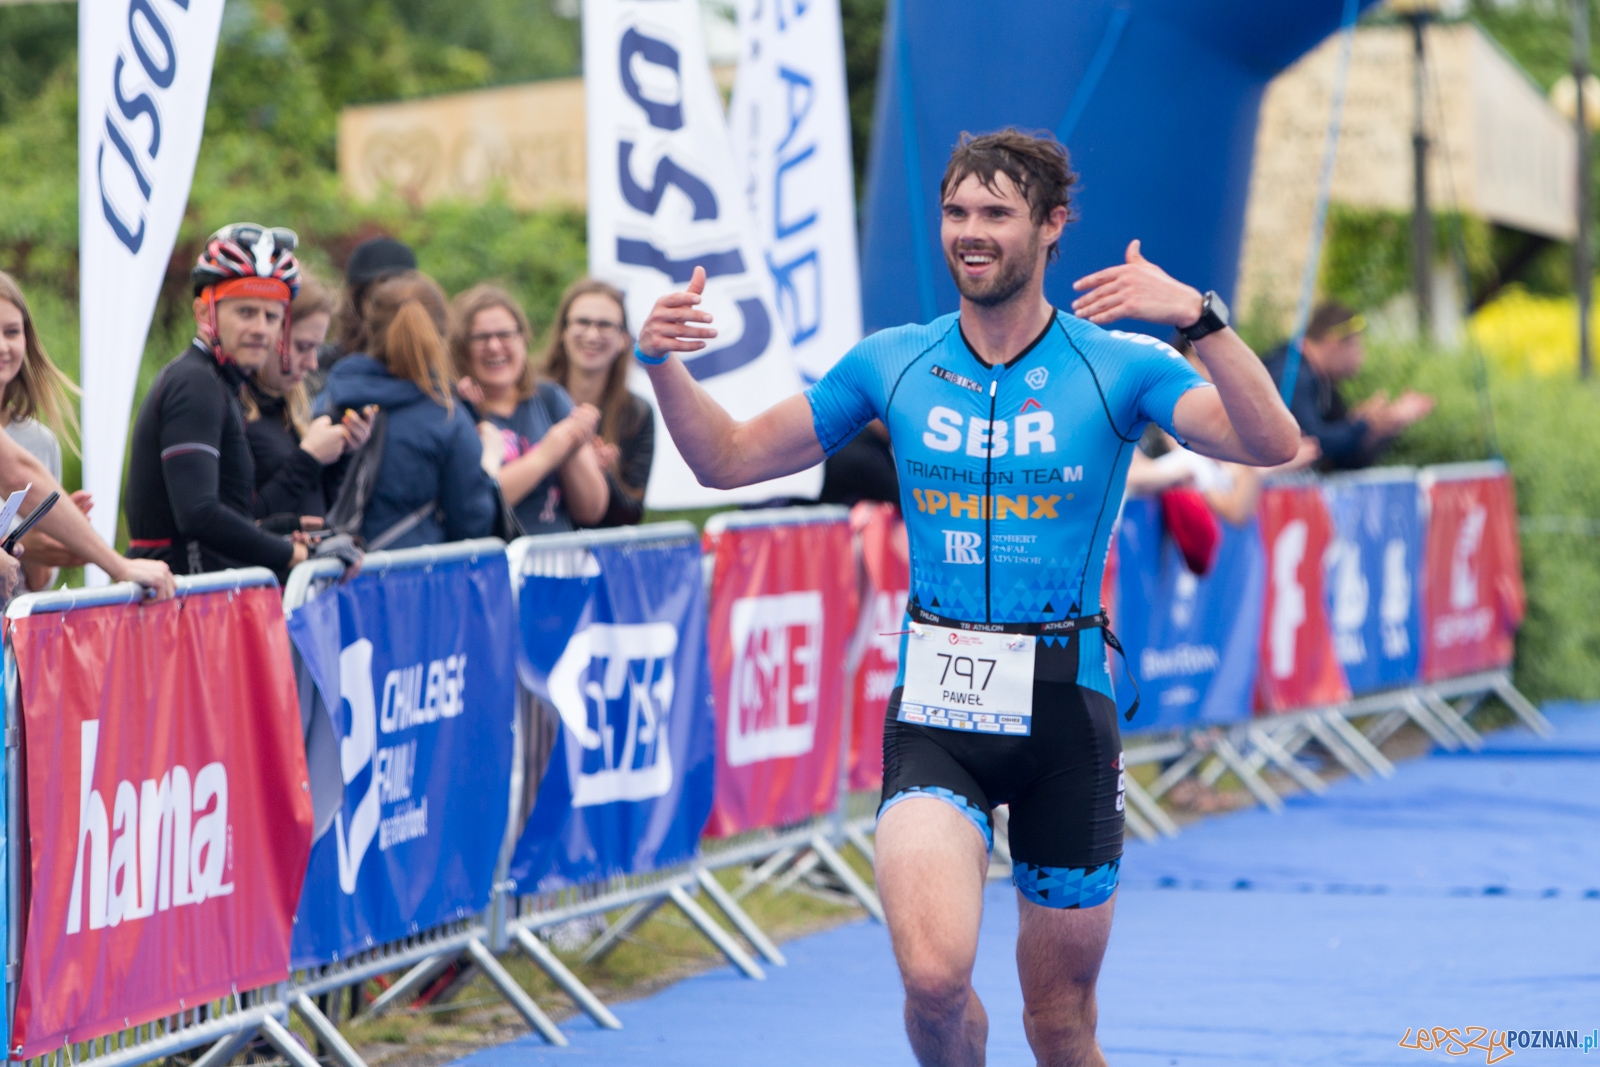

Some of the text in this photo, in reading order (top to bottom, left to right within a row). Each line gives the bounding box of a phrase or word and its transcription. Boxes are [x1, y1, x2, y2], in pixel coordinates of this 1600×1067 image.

[922, 403, 1057, 459] SBR
[905, 459, 1084, 486] TRIATHLON TEAM
[912, 487, 1062, 521] SPHINX
[936, 652, 997, 691] 797
[942, 689, 984, 707] PAWEŁ
[65, 718, 235, 936] hama
